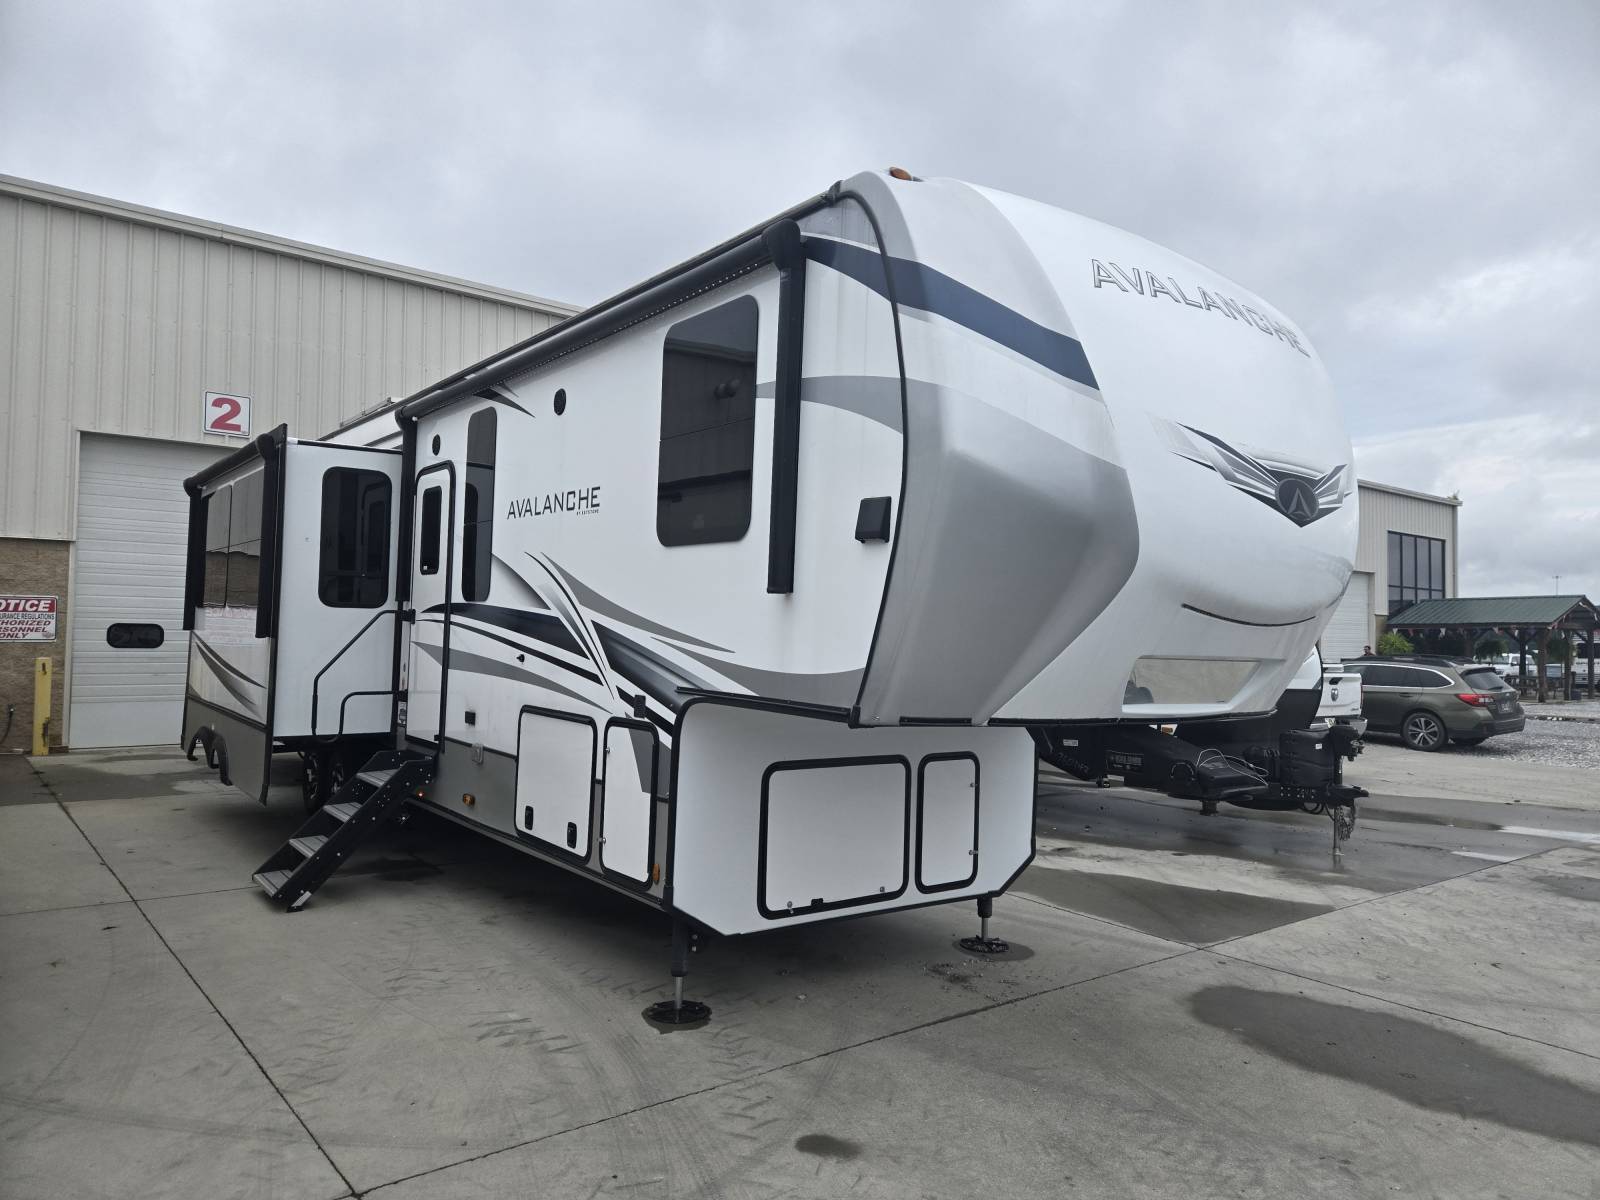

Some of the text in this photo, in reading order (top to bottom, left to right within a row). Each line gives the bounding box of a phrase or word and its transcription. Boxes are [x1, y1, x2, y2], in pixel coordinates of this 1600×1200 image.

[1091, 258, 1311, 358] AVALANCHE
[210, 397, 241, 432] 2
[507, 486, 601, 520] AVALANCHE
